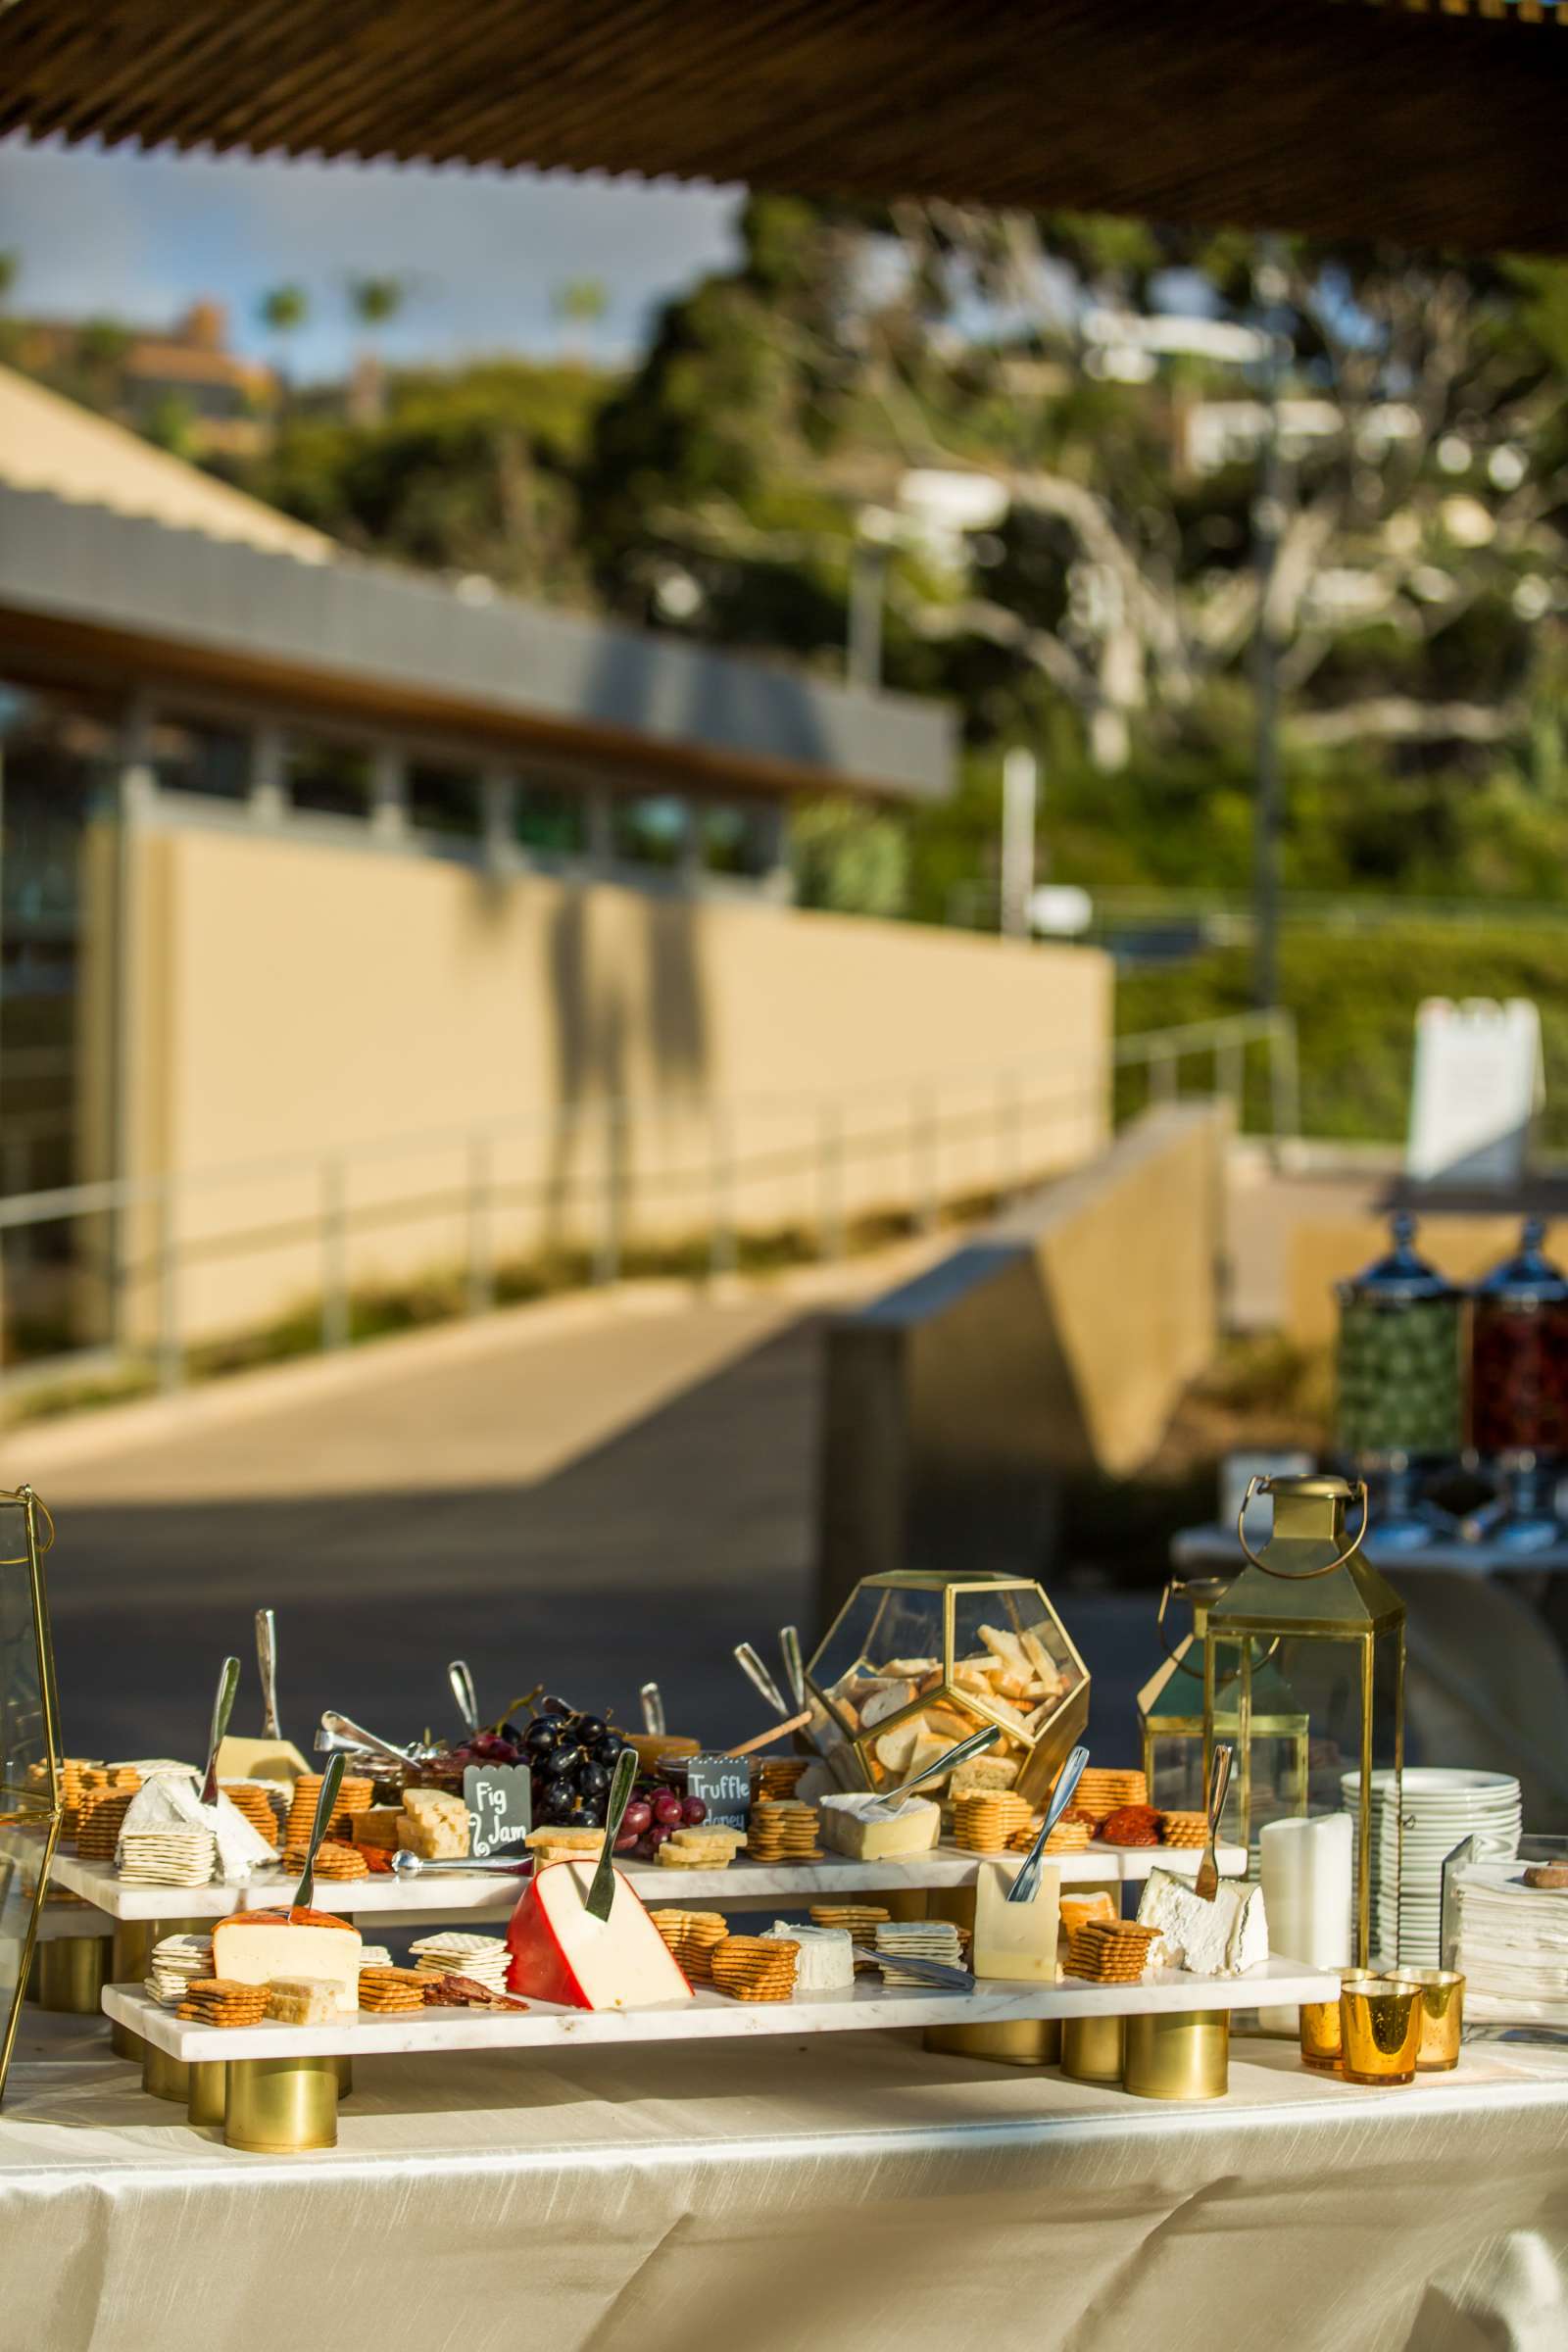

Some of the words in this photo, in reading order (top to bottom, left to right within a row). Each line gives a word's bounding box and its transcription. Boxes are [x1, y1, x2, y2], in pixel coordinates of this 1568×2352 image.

[475, 1782, 507, 1815] Fig
[688, 1774, 750, 1799] Truffle
[488, 1815, 526, 1844] Jam
